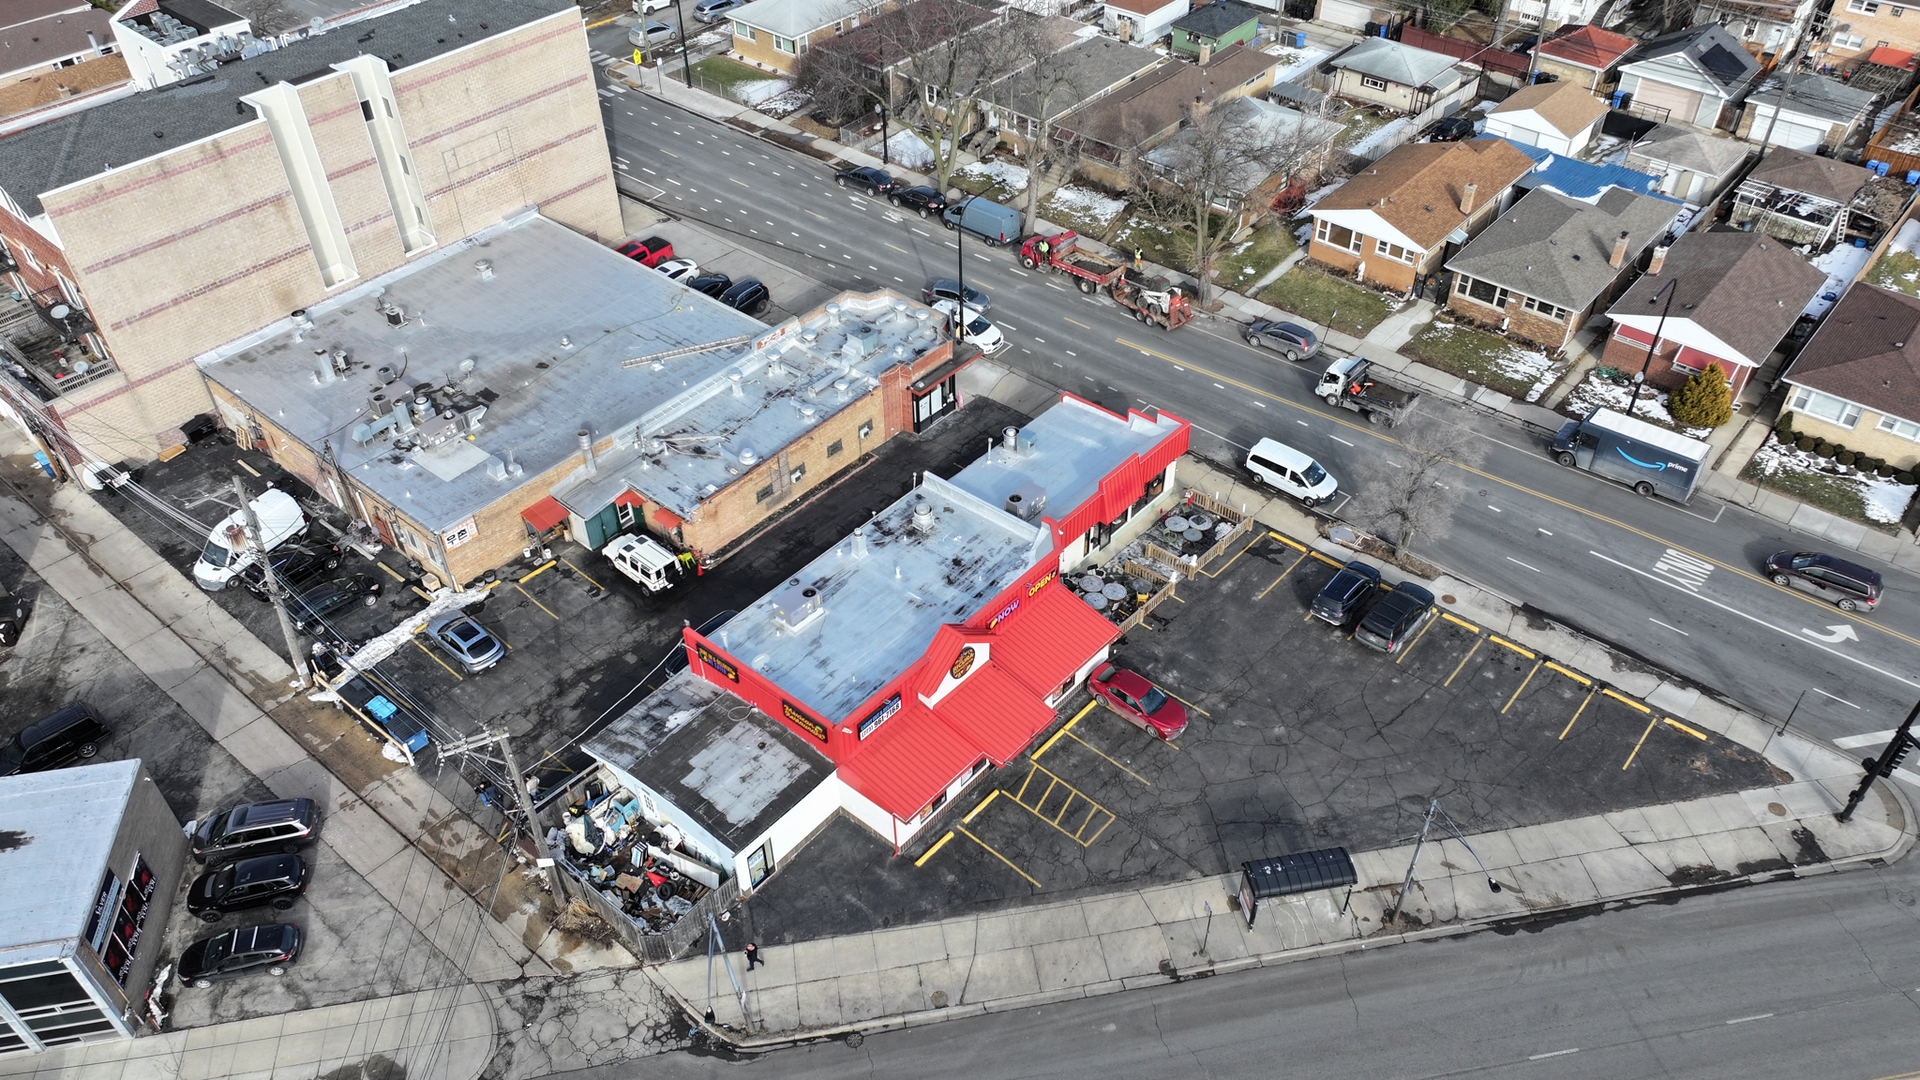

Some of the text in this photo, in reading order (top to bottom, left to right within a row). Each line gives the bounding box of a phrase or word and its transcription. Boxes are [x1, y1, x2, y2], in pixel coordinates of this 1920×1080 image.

[1667, 462, 1688, 473] prime
[1652, 548, 1715, 592] ONLY
[997, 572, 1052, 623] NOW OPEN
